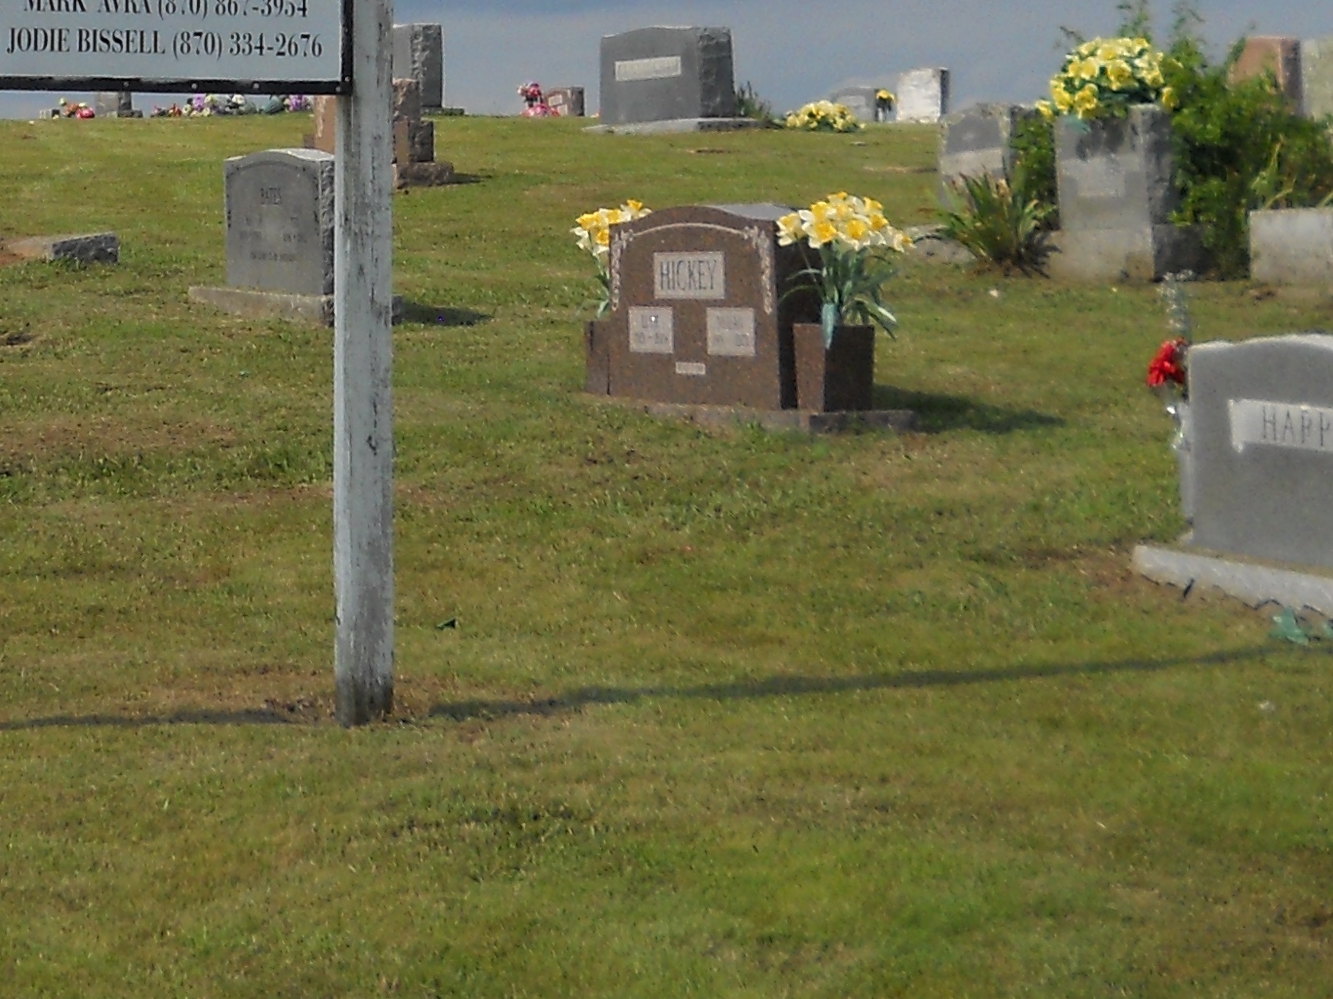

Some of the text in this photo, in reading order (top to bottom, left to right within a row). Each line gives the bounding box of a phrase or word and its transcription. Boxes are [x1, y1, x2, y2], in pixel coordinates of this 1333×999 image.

[6, 27, 71, 54] JODIE
[77, 28, 166, 55] BISSELL
[172, 30, 223, 60] (870)
[228, 32, 323, 58] 334-2676
[659, 259, 717, 291] HICKEY
